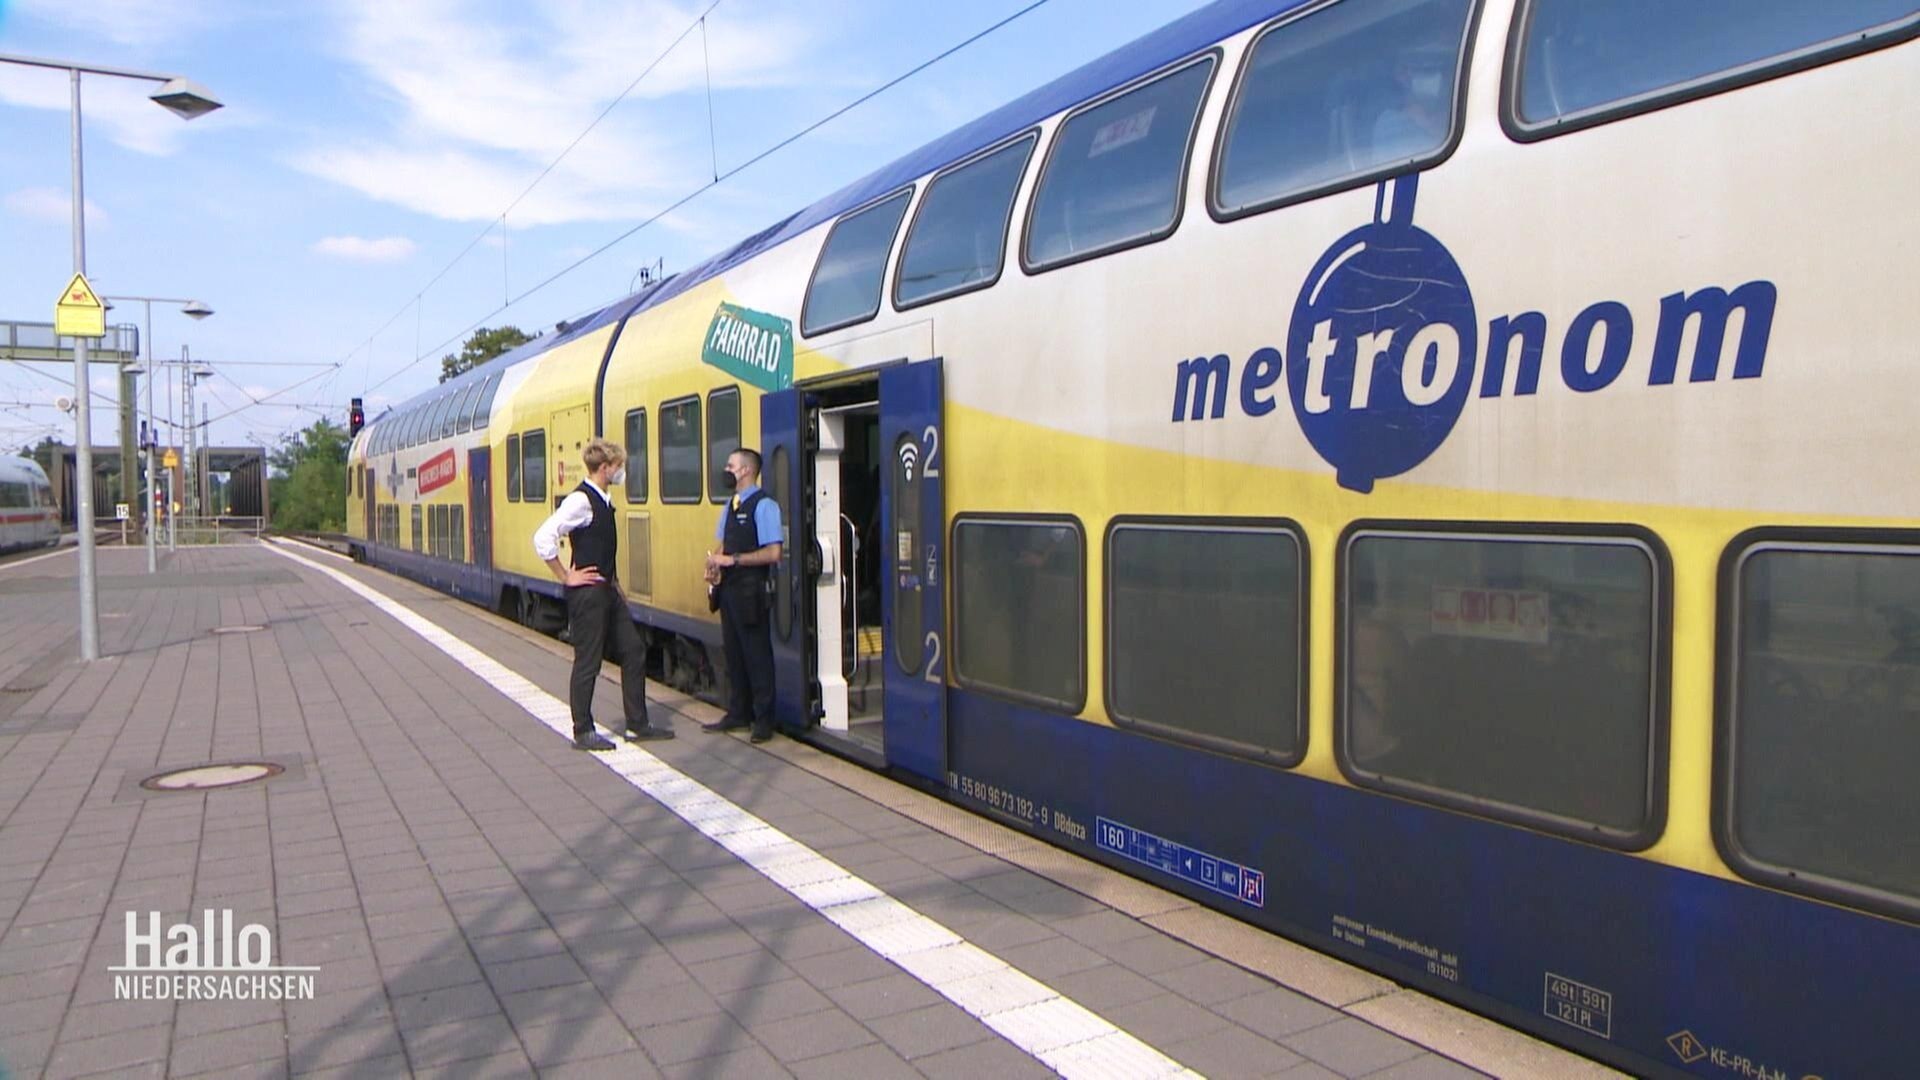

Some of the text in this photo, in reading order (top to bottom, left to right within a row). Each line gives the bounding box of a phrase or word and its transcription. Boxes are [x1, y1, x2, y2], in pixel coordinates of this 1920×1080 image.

[710, 315, 781, 373] FAHRRAD
[1172, 279, 1777, 423] metronom
[922, 425, 939, 478] 2
[925, 631, 941, 683] 2
[1102, 824, 1125, 849] 160
[1681, 1037, 1692, 1056] R
